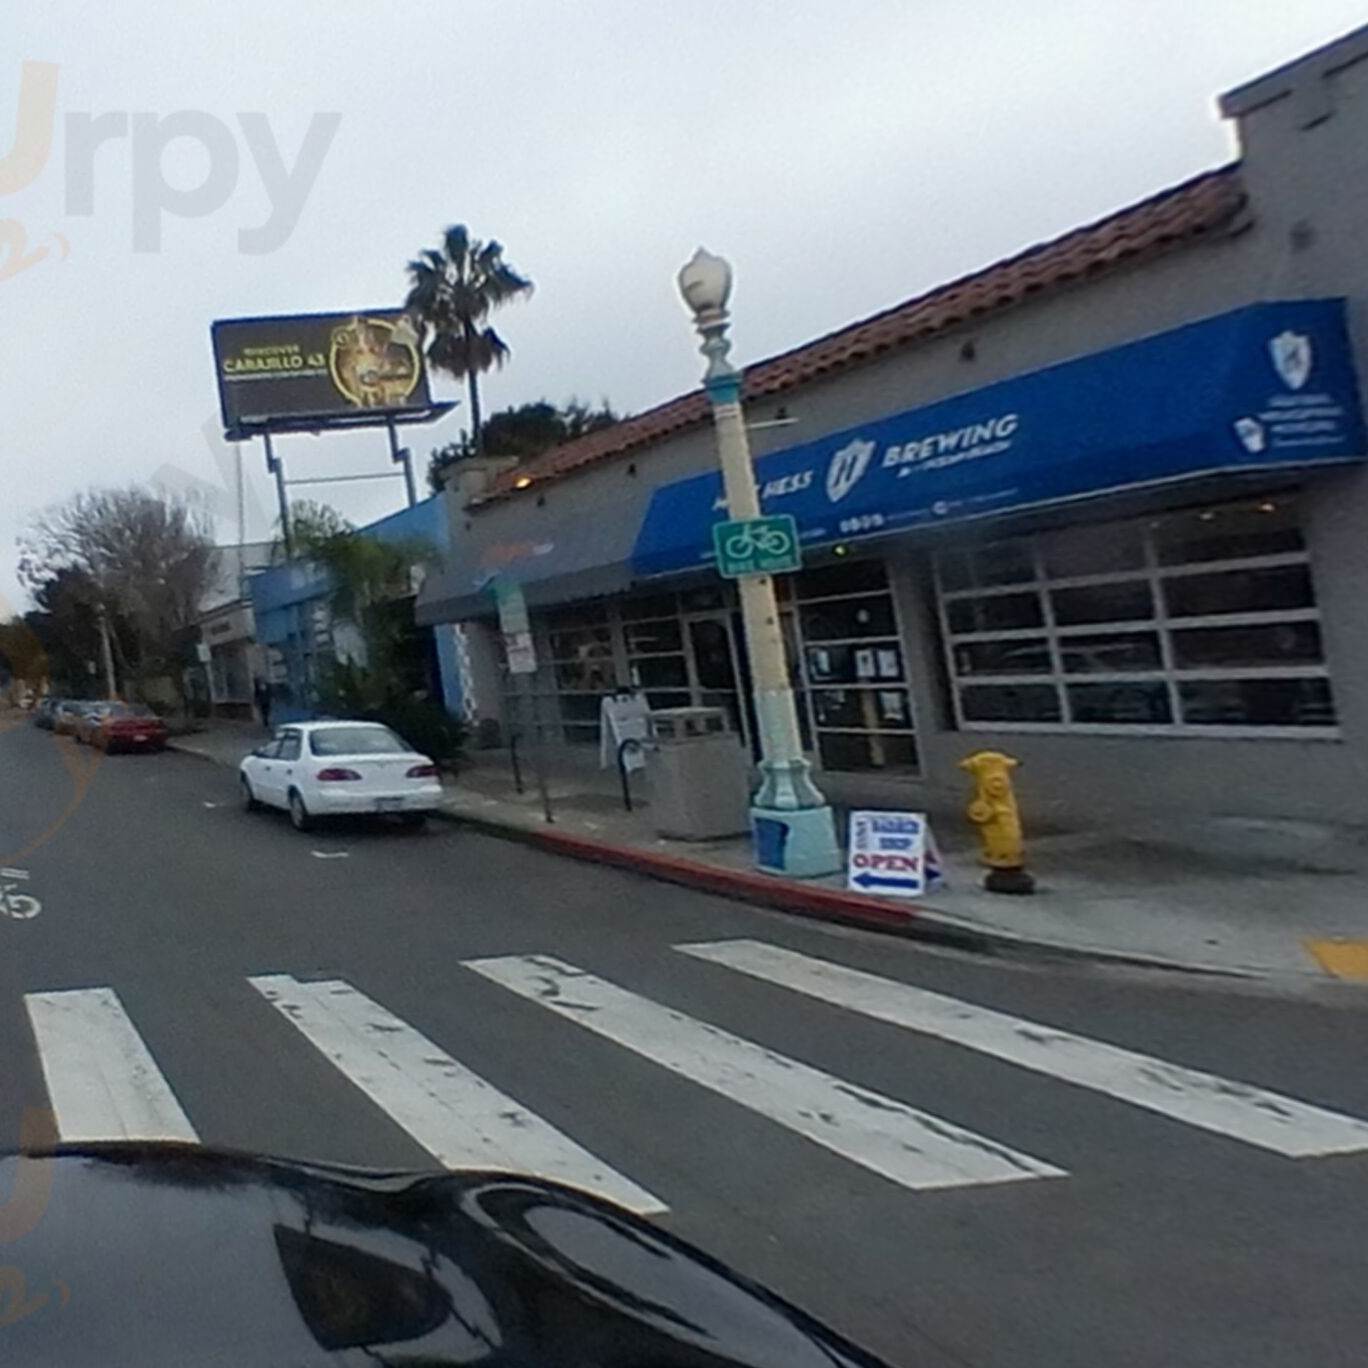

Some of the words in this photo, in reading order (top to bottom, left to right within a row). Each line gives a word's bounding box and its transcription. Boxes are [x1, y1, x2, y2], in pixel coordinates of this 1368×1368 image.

[223, 355, 303, 373] CARAJILLO
[307, 353, 326, 367] 43
[761, 470, 814, 499] HESS
[881, 413, 1019, 469] BREWING
[852, 853, 920, 872] OPEN
